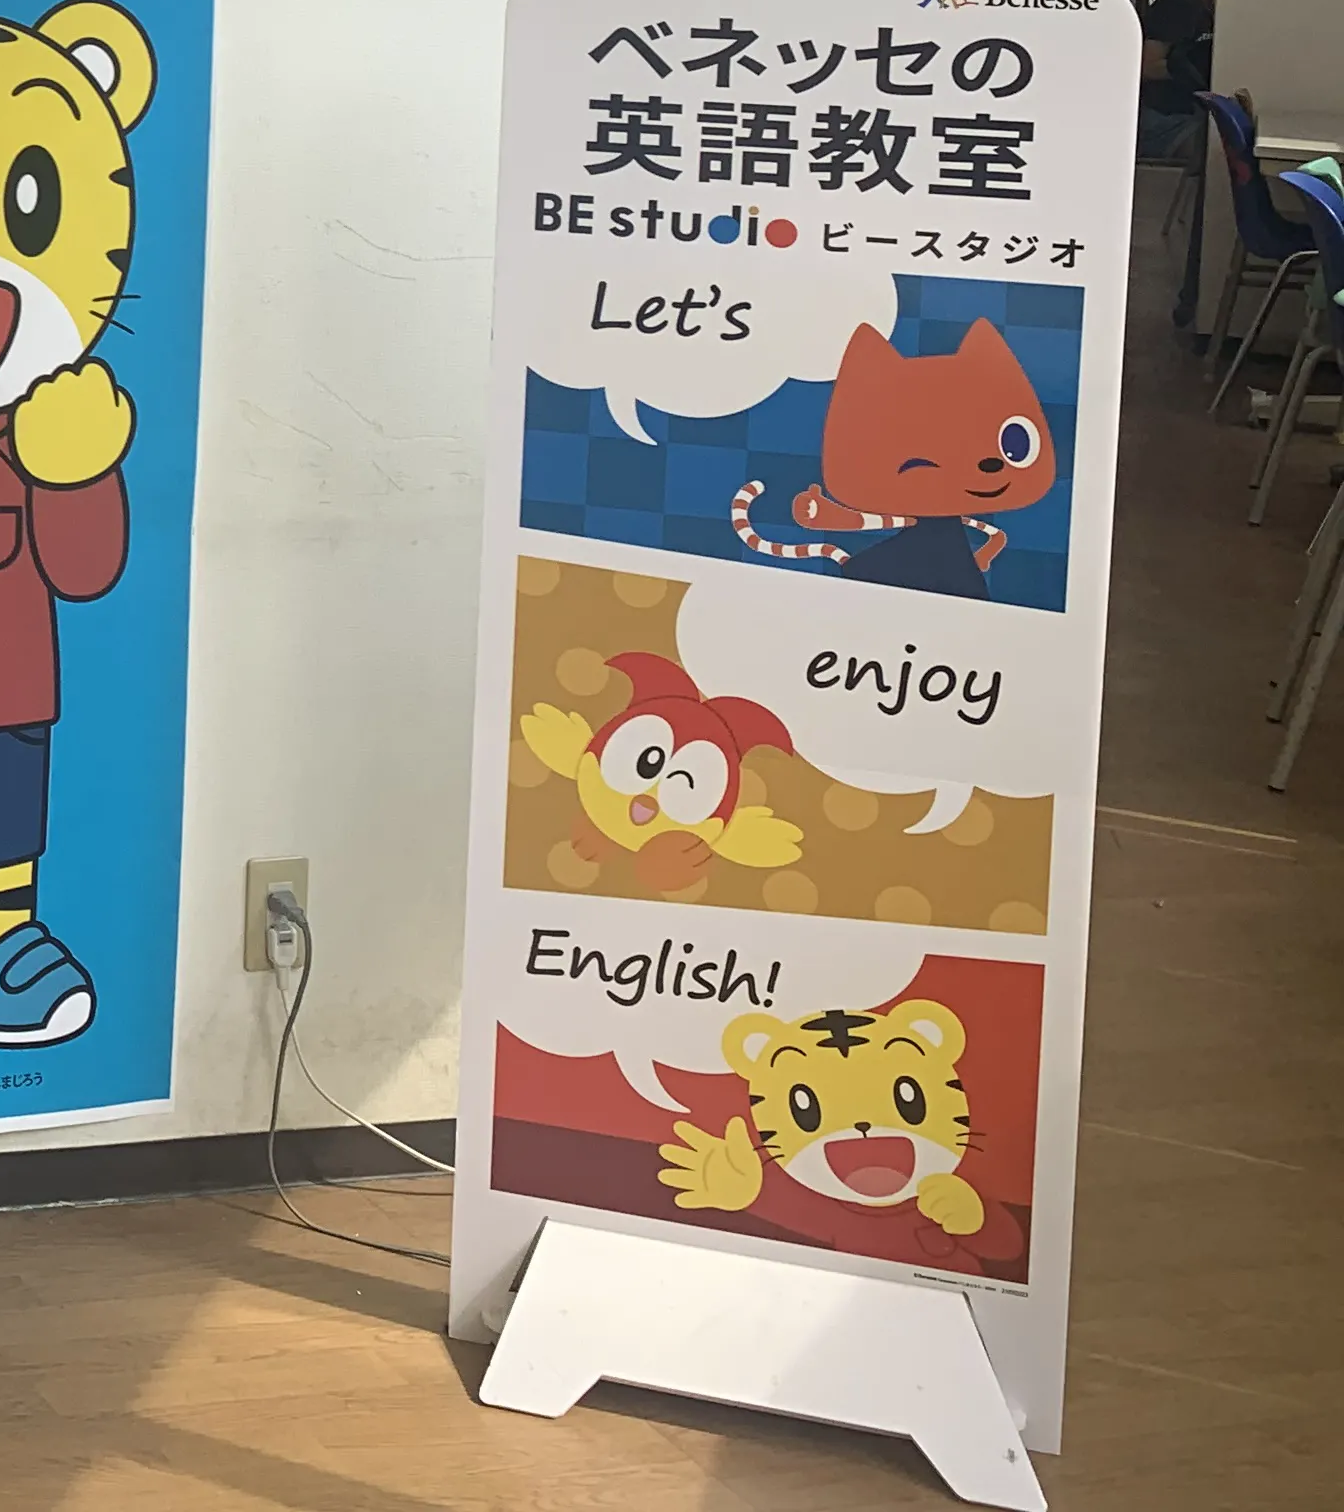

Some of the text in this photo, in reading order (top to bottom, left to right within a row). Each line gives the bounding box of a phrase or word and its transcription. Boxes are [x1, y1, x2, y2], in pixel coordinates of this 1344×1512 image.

[587, 17, 1034, 99] ベネッセの
[583, 93, 1035, 201] 英語教室
[533, 193, 1086, 269] BE studio ビースタジオ
[591, 280, 753, 342] Let's
[805, 643, 1003, 726] enjoy
[525, 928, 782, 1008] English!
